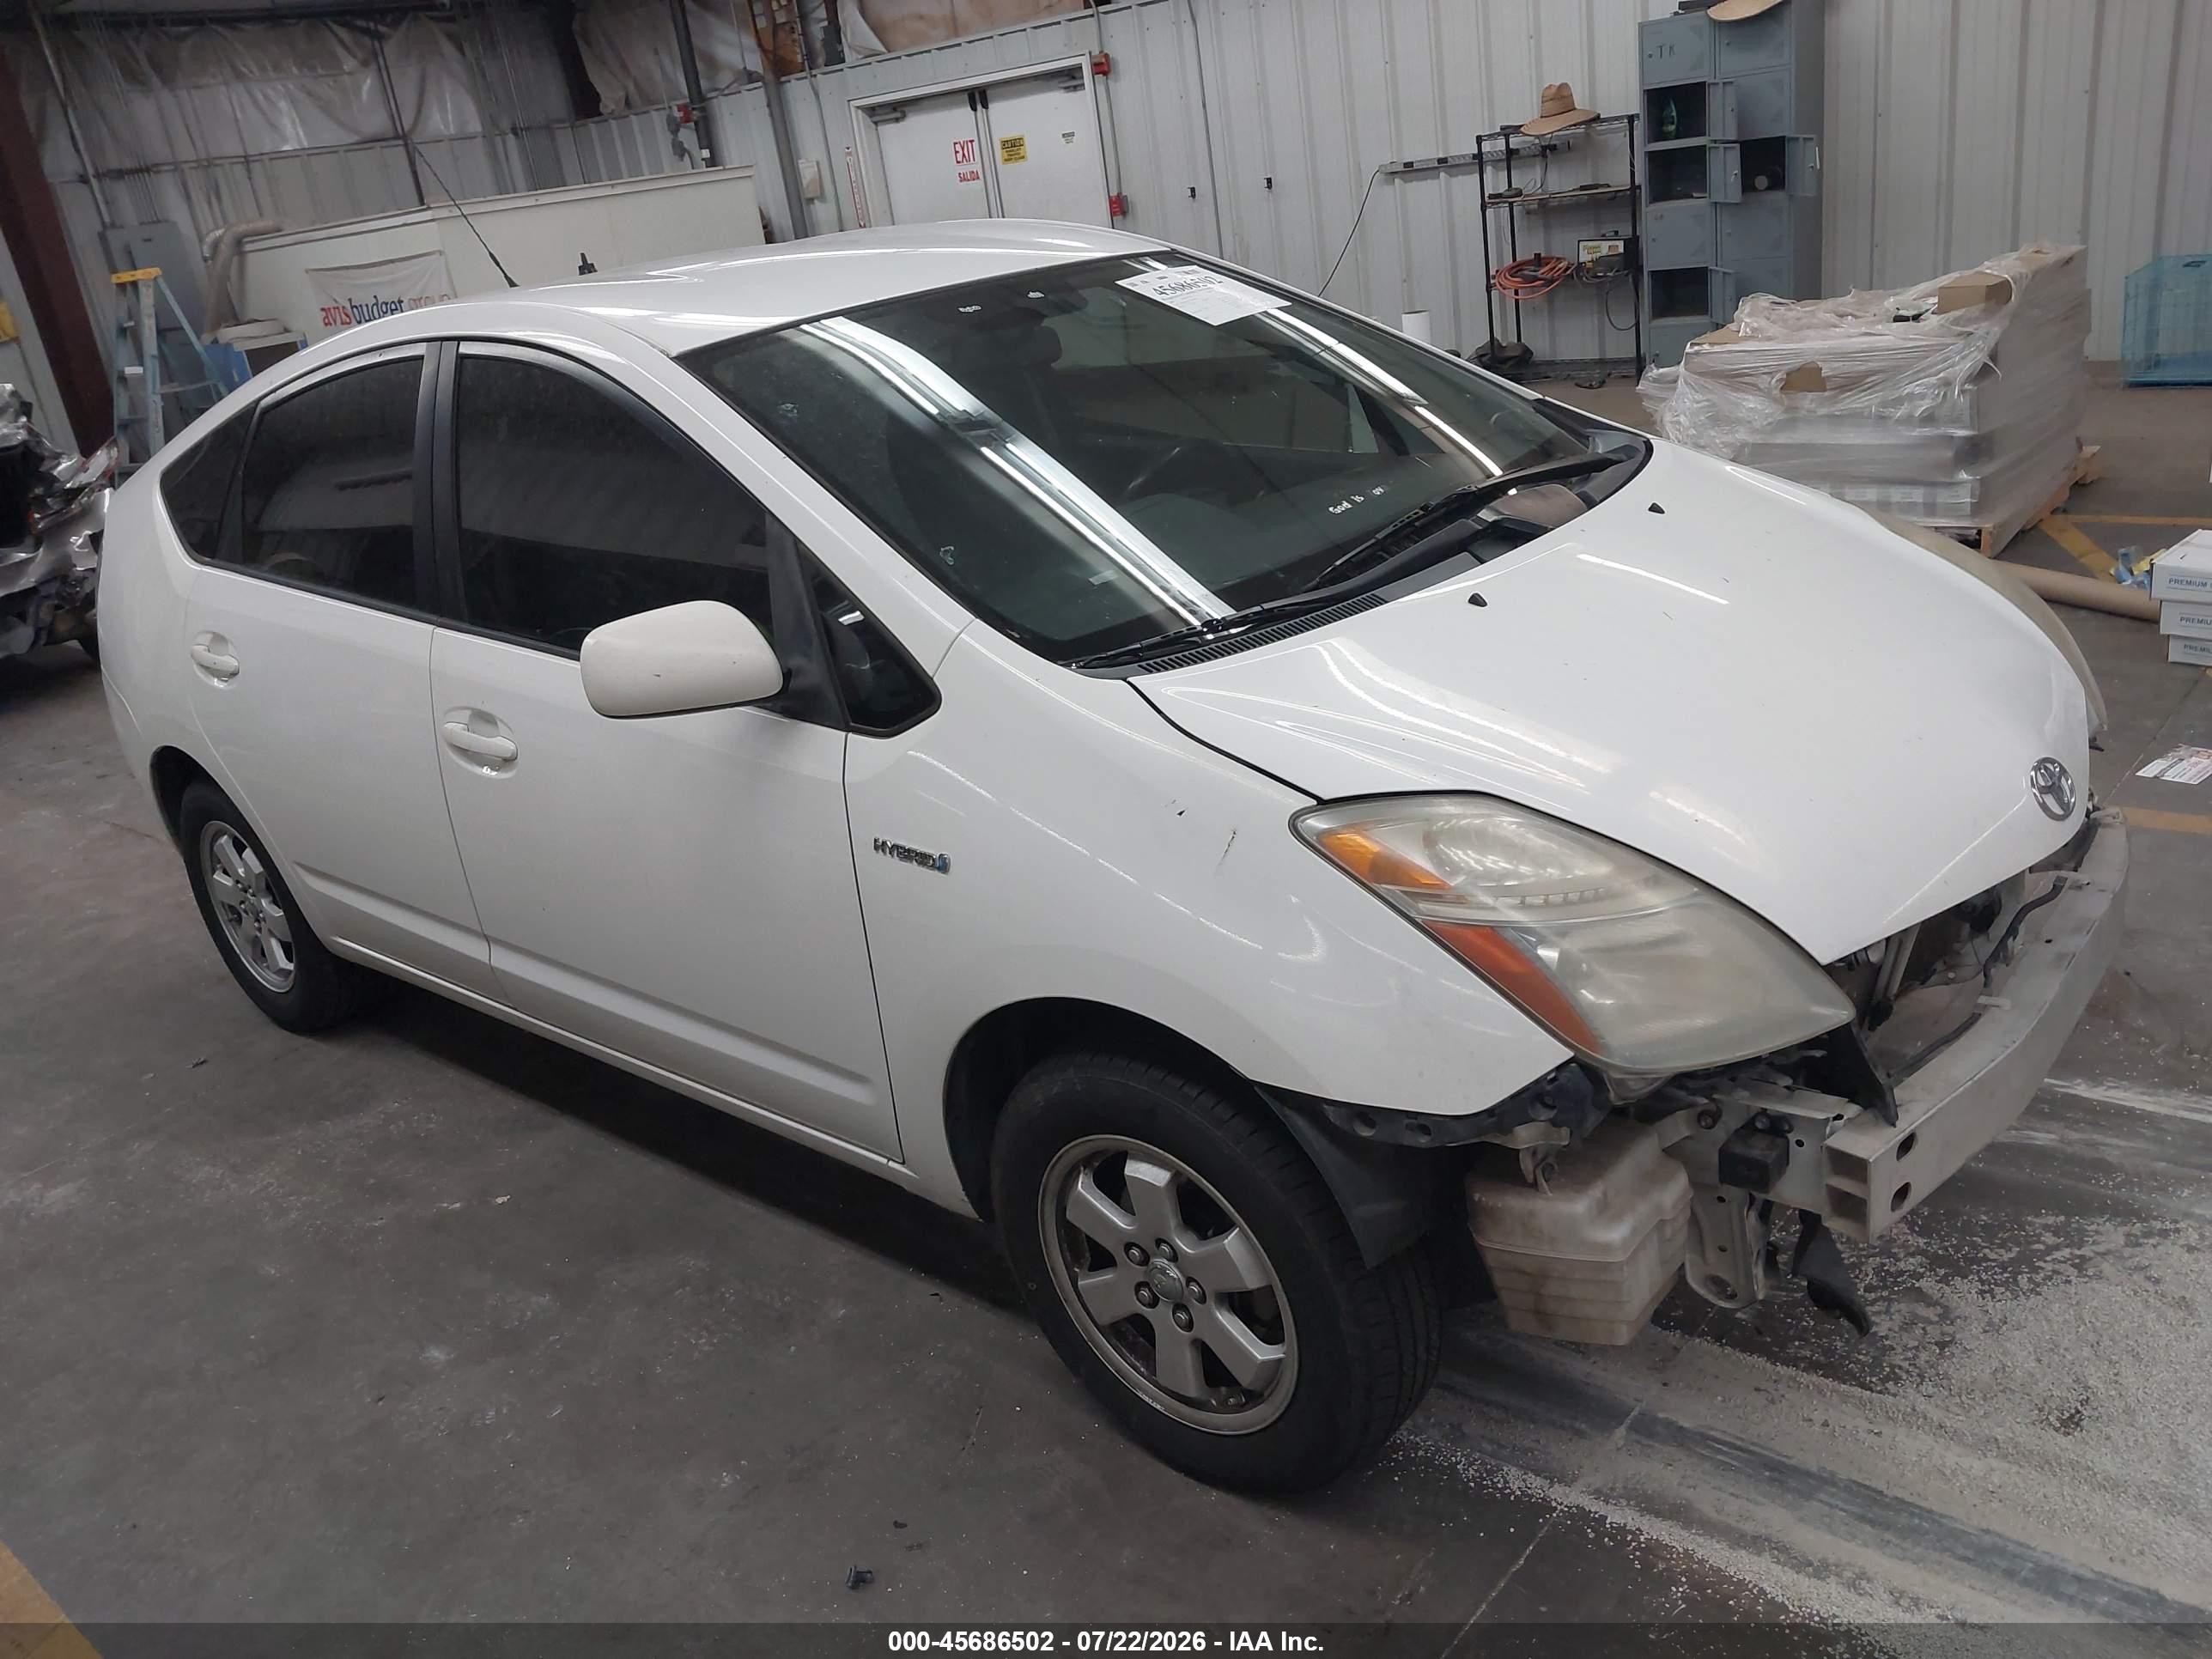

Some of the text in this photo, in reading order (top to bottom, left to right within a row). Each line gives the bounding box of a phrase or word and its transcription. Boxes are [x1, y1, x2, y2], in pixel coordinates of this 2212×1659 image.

[953, 139, 975, 164] EXIT
[958, 170, 981, 183] SALIDA
[2168, 577, 2208, 589] PREMIUM
